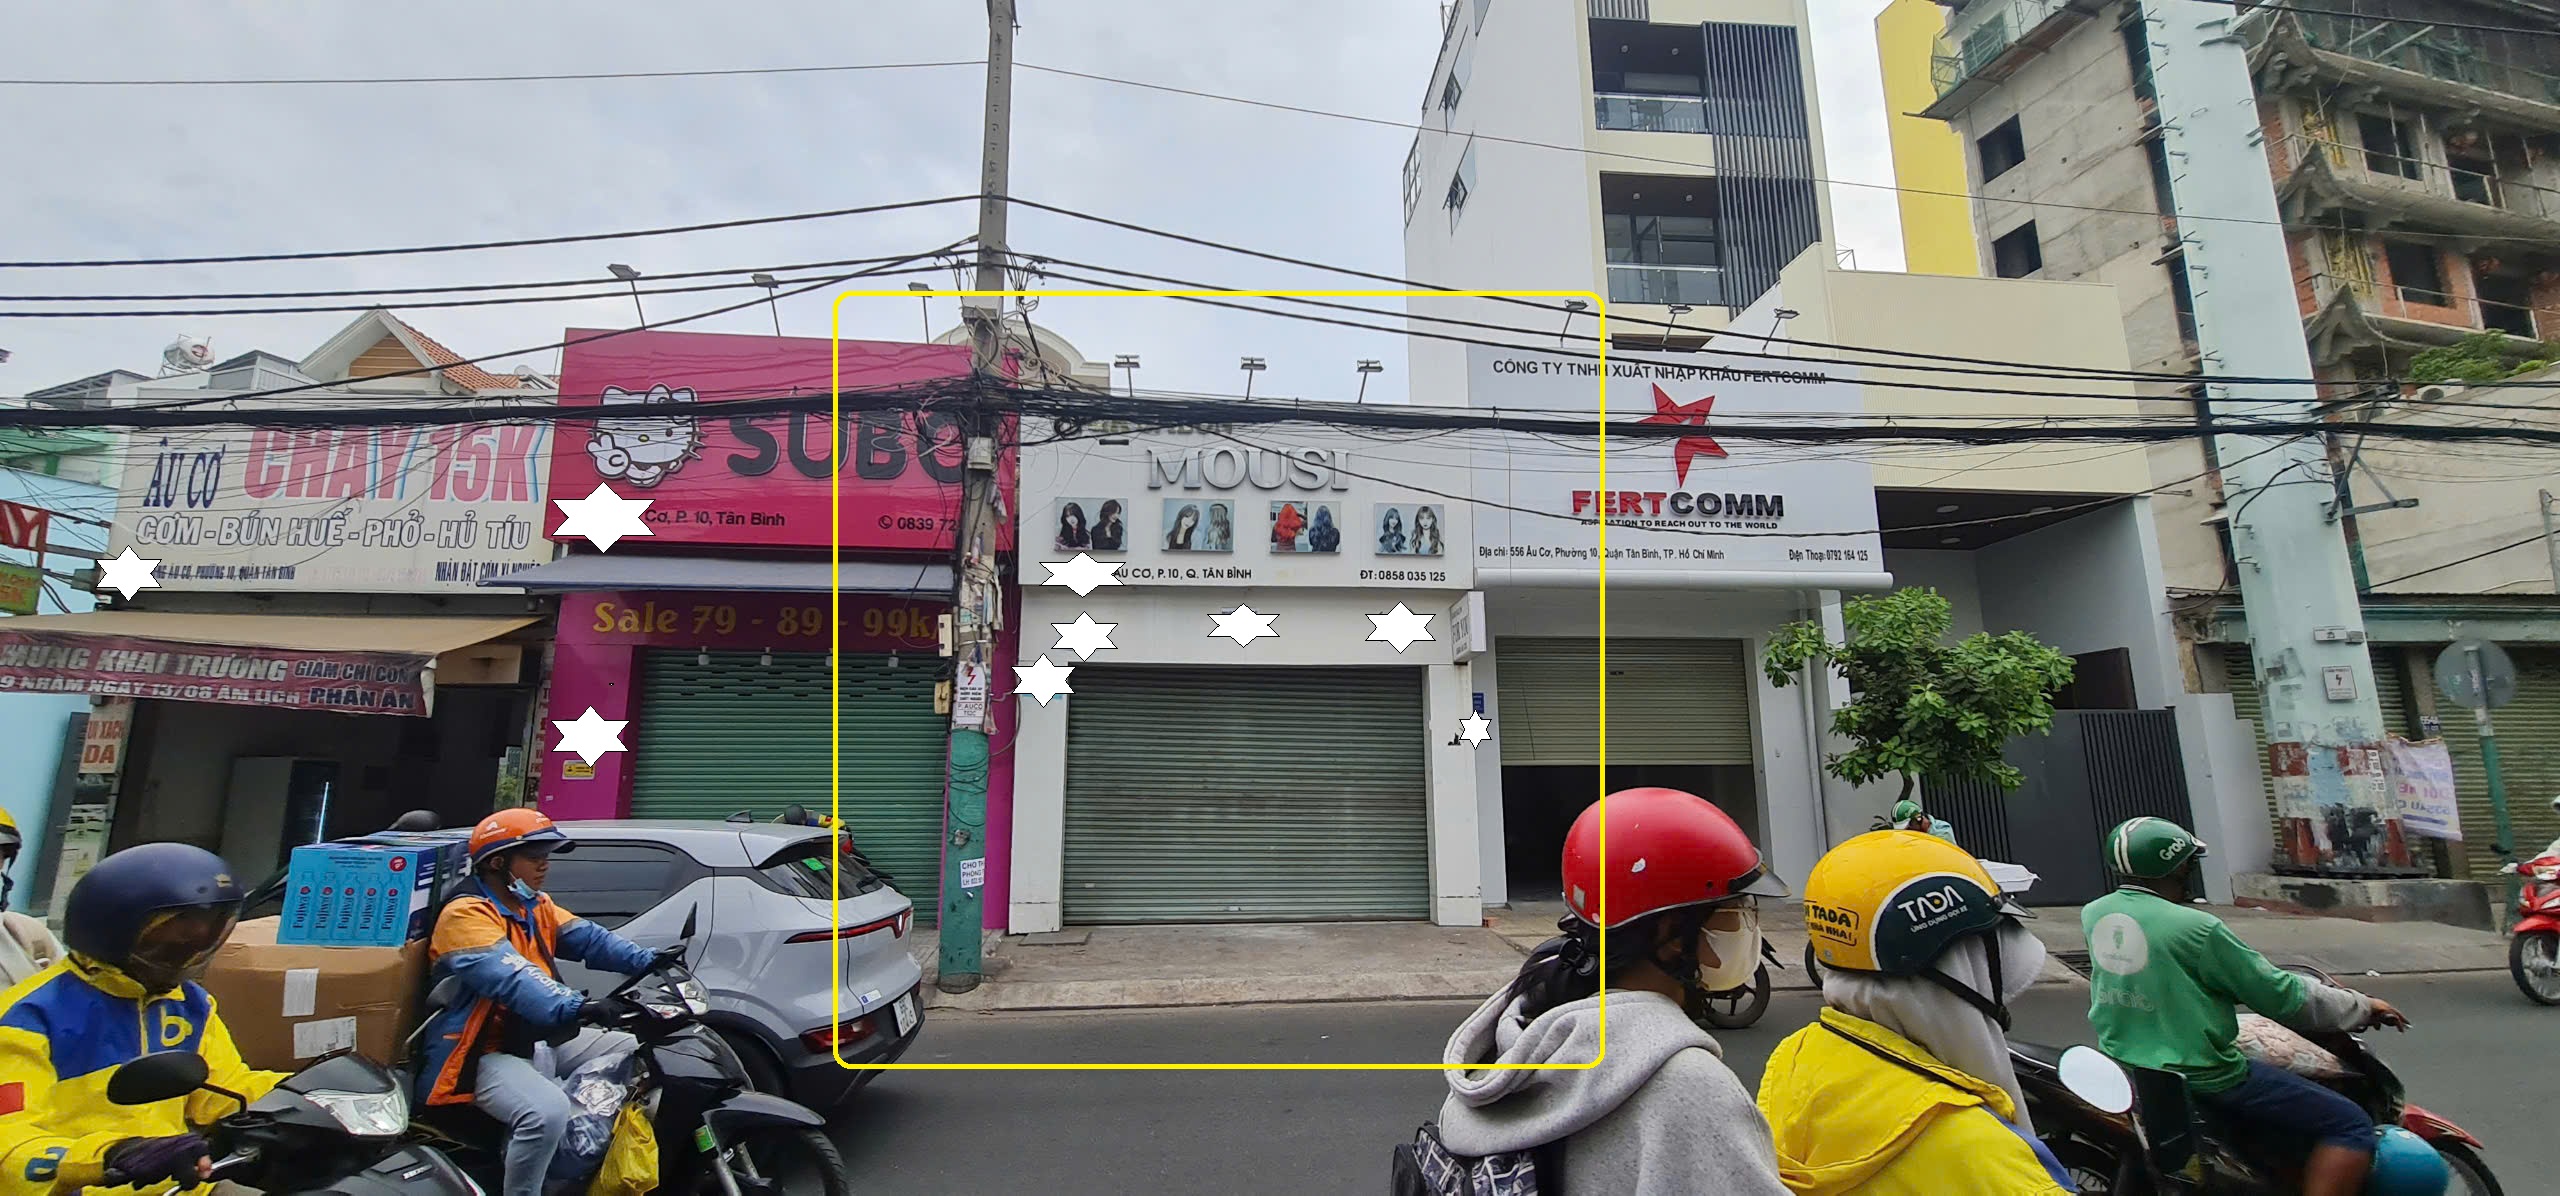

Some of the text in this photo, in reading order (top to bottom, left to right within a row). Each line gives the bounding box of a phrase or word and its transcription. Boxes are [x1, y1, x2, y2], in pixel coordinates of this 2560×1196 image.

[1493, 358, 1538, 374] CÔNG
[1542, 361, 1562, 375] TY
[1567, 362, 1608, 377] TNHH
[1612, 362, 1651, 378] XUẤT
[1655, 365, 1696, 382] NHẬP
[143, 436, 226, 508] ÂU CƠ
[244, 422, 541, 502] CHAY 15K
[1147, 446, 1350, 491] MOUSI
[1572, 489, 1785, 518] FERTCOMM
[136, 512, 203, 546] CƠM
[218, 510, 281, 547] BÚN
[287, 507, 354, 547] HUẾ
[362, 509, 425, 548] PHỞ
[437, 510, 477, 549] HỦ
[486, 514, 531, 550] TÍU
[716, 511, 745, 525] Tân
[751, 512, 785, 526] Bình
[897, 517, 960, 532] 0839 72
[1640, 519, 1653, 527] TO
[1655, 520, 1685, 528] REACH
[1688, 520, 1706, 528] OUT
[1709, 521, 1722, 529] TO
[1725, 521, 1743, 529] THE
[1745, 522, 1778, 530] WORLD
[1479, 545, 1492, 559] Địa
[1510, 546, 1524, 557] 556
[1526, 545, 1537, 557] Âu
[1555, 546, 1588, 561] Phường
[1626, 548, 1640, 559] Tân
[1707, 549, 1725, 560] Minh
[1857, 550, 1868, 561] 125
[1186, 568, 1199, 579] Q.
[1203, 566, 1224, 579] TÂN
[1227, 566, 1252, 580] BÌNH
[1407, 571, 1427, 582] 035
[1429, 571, 1446, 582] 125
[593, 601, 678, 634] Sale
[693, 604, 736, 634] 79
[777, 606, 823, 636] 89
[96, 649, 169, 674] KHAI
[84, 744, 115, 764] DA
[2159, 837, 2187, 861] Grab
[962, 861, 977, 870] CHO
[1898, 885, 1964, 922] TADA
[1812, 904, 1851, 928] TADA
